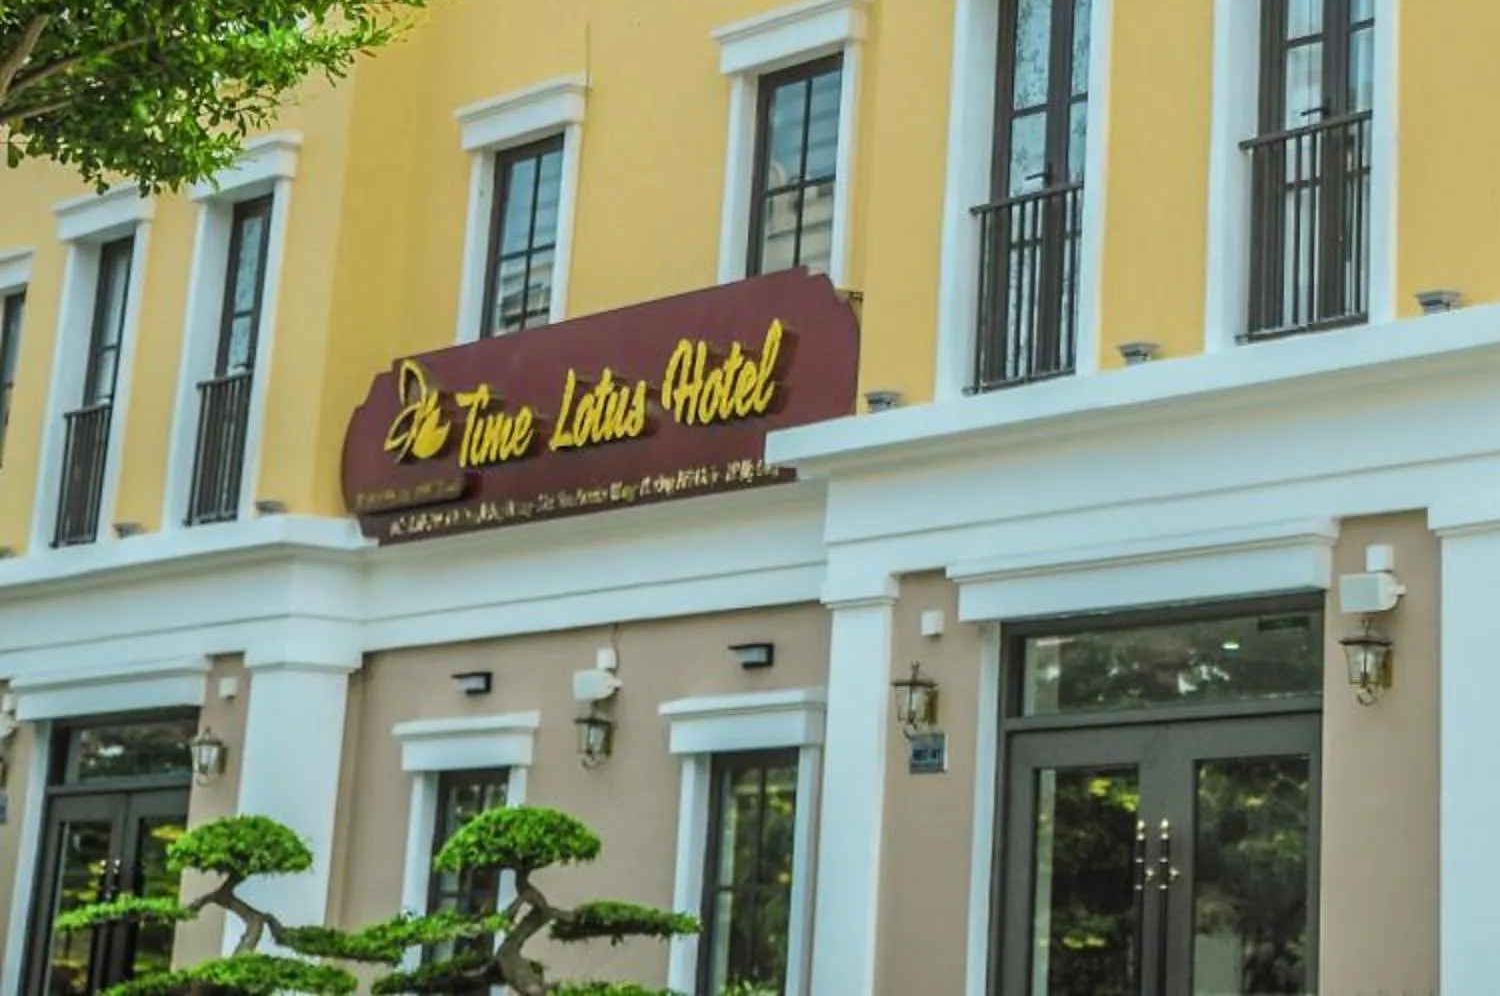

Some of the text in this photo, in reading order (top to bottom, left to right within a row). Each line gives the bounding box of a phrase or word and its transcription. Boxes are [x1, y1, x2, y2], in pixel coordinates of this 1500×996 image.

[456, 317, 784, 468] Time Lotus Hotel
